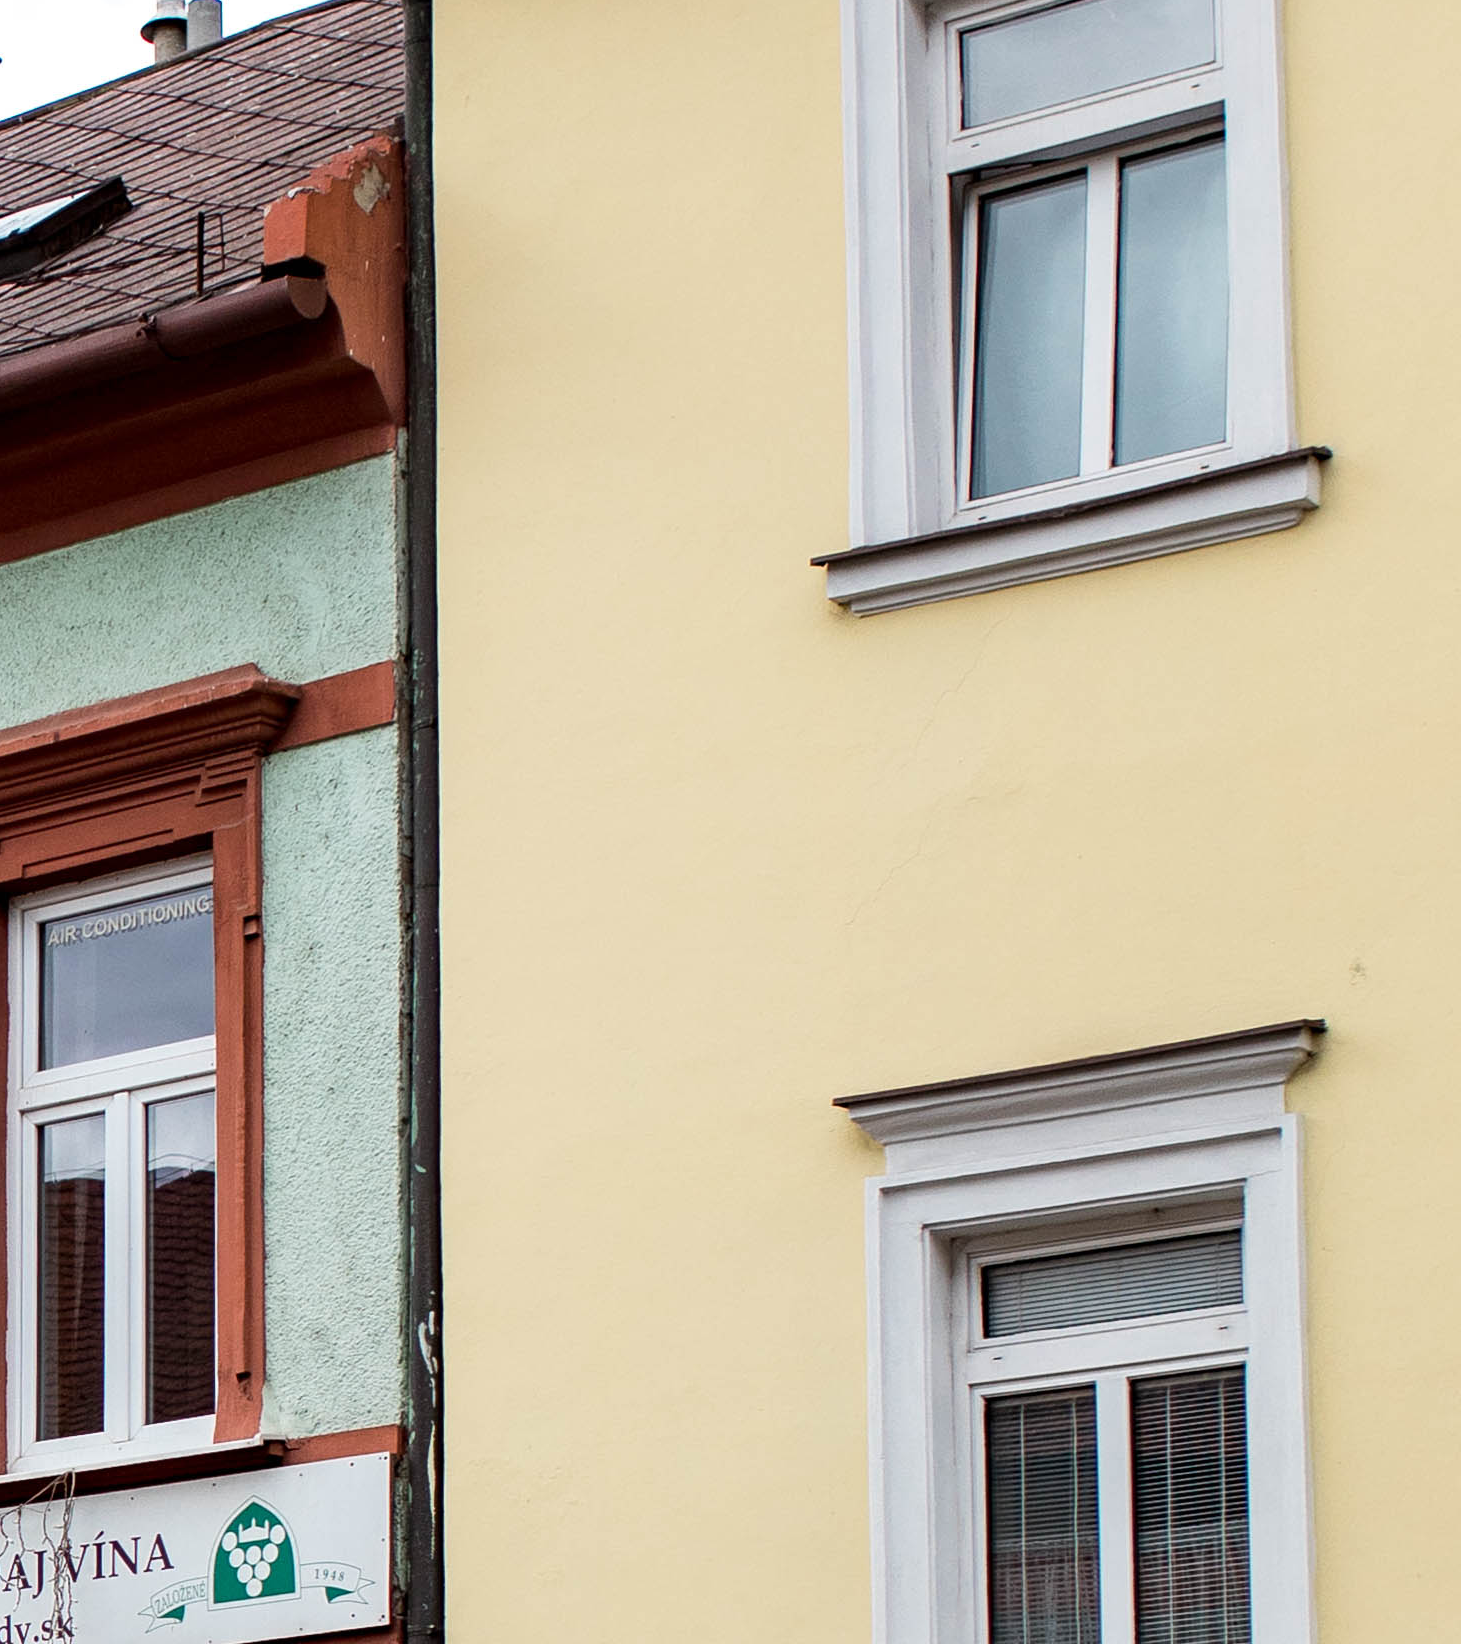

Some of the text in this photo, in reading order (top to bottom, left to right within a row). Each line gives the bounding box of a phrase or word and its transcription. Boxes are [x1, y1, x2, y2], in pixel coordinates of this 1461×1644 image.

[64, 1530, 175, 1584] VÍNA
[314, 1568, 345, 1582] 1948
[154, 1581, 207, 1614] ZALOŽENÉ
